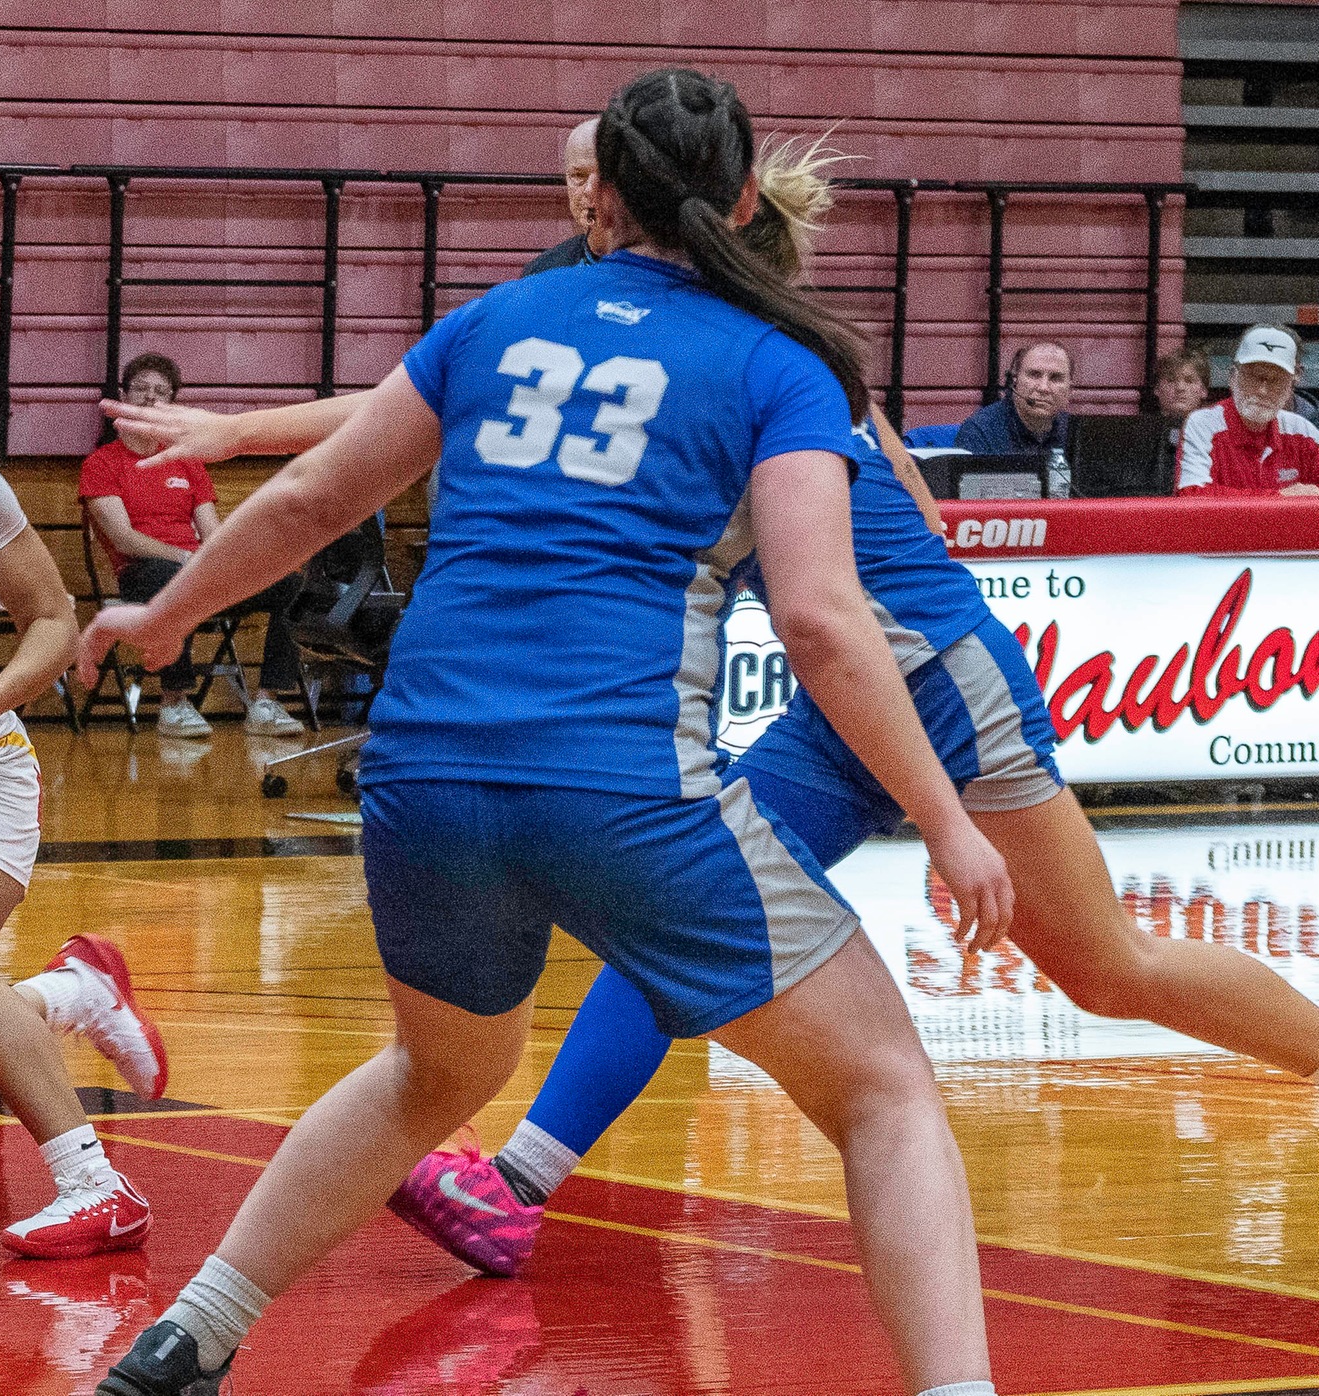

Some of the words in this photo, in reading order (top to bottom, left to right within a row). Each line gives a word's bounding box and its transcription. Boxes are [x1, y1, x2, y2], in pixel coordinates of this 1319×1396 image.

[474, 337, 670, 487] 33
[941, 518, 1048, 549] .com
[977, 574, 1031, 599] me
[1046, 568, 1086, 599] to
[1209, 735, 1319, 766] Comm
